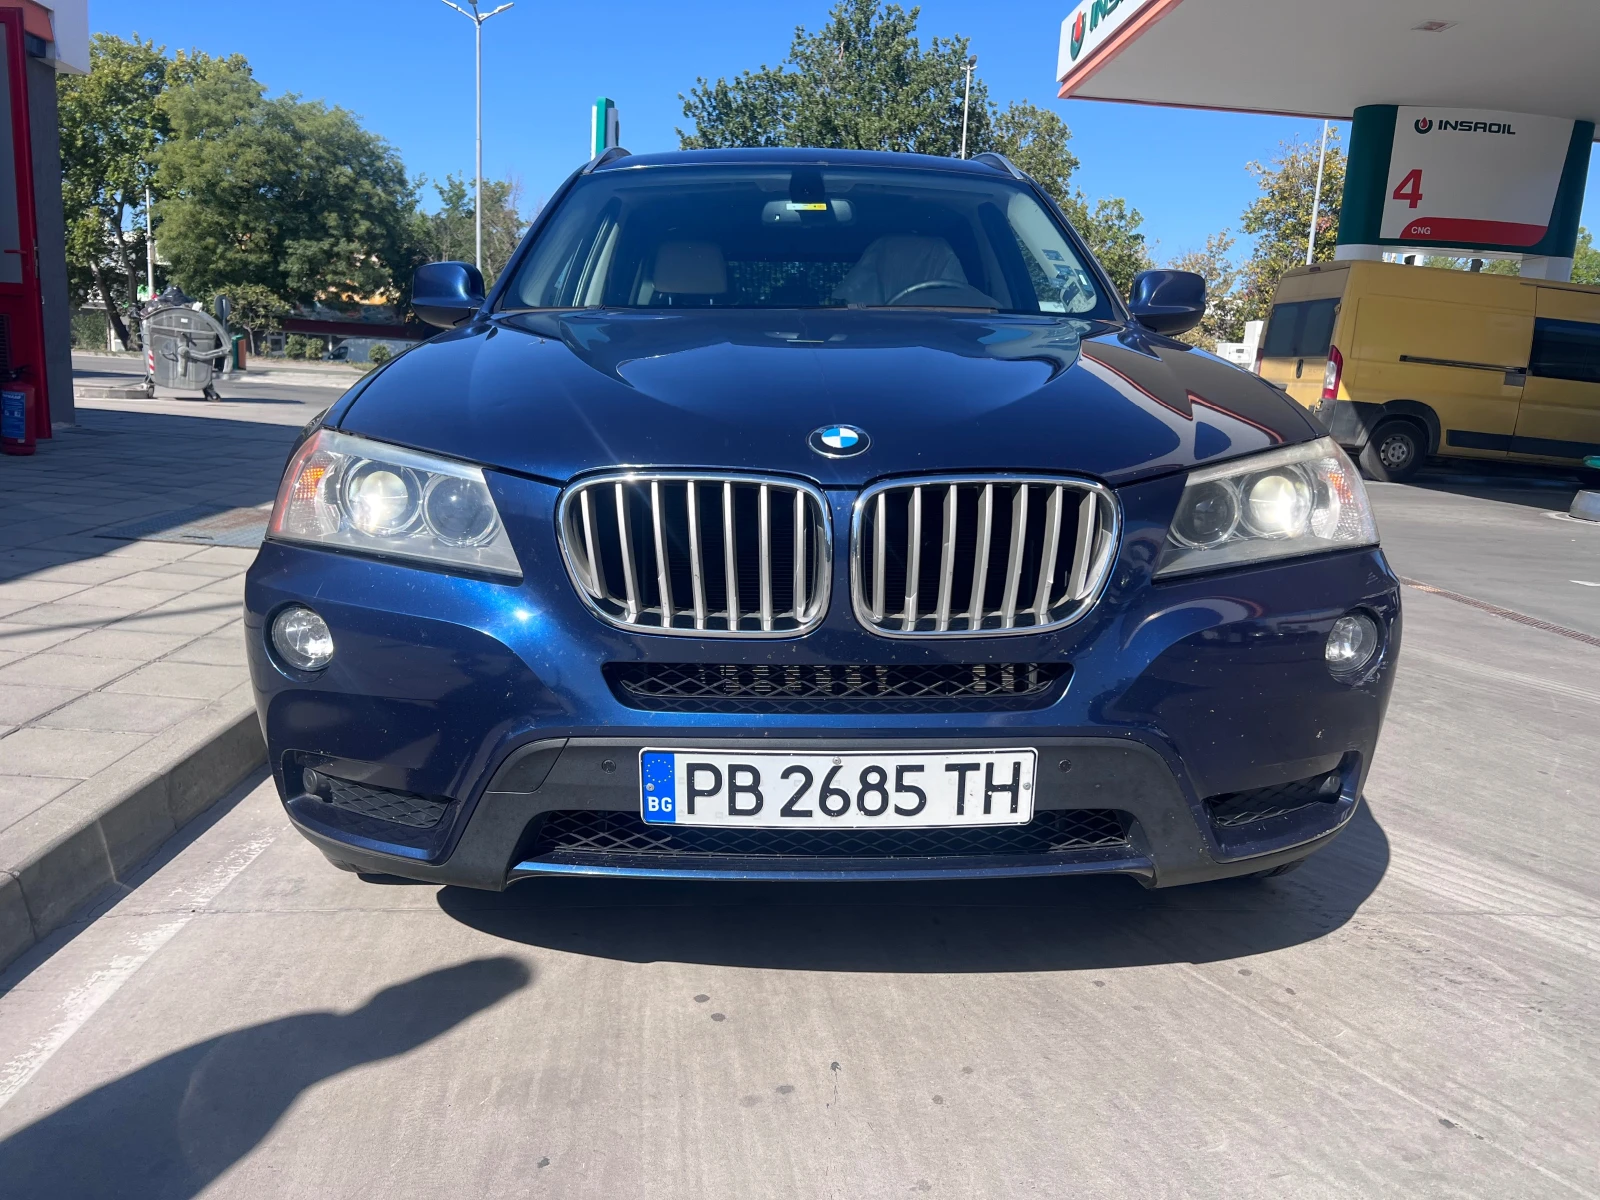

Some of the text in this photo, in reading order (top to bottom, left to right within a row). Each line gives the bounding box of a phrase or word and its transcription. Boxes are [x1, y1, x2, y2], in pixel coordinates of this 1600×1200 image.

[1438, 120, 1516, 135] INSAOIL
[1393, 169, 1423, 209] 4
[1411, 226, 1431, 235] CNG
[686, 762, 1020, 817] PB 2685 TH
[648, 797, 673, 812] BG
